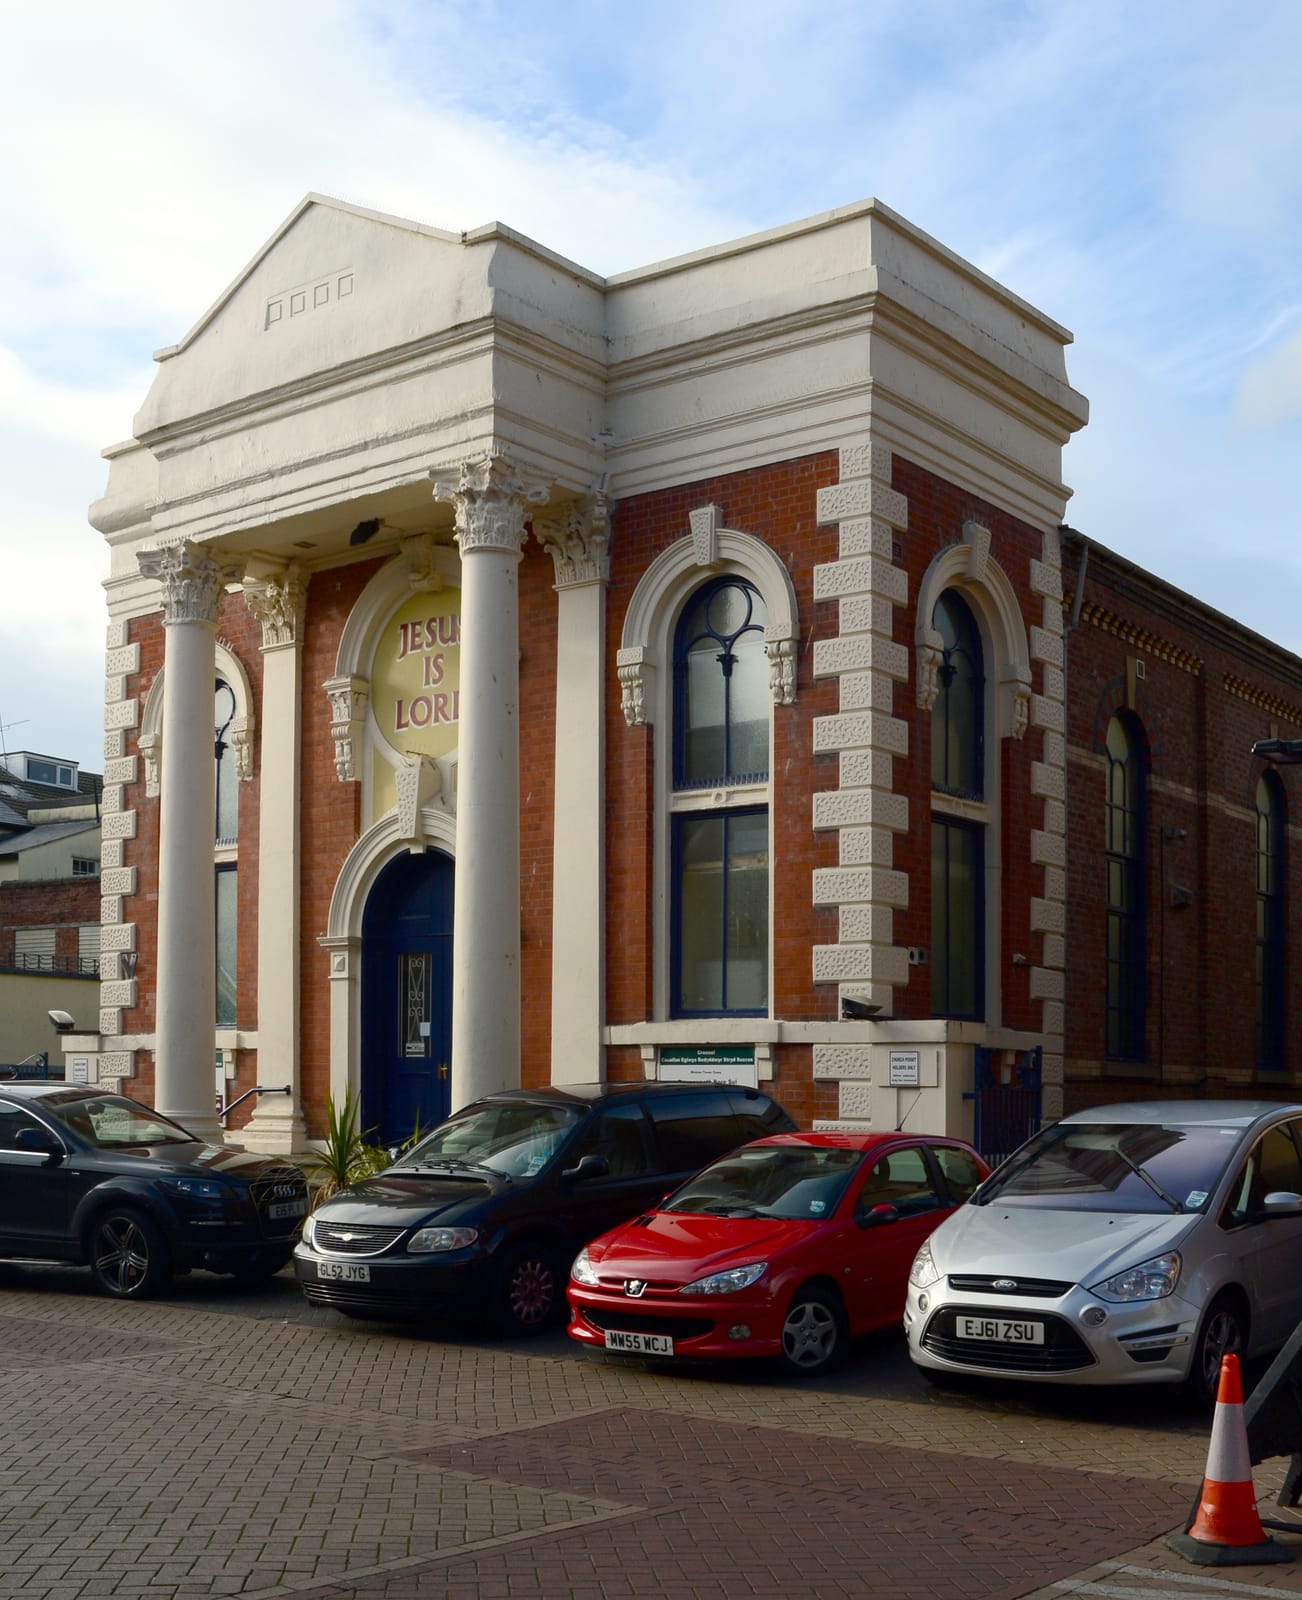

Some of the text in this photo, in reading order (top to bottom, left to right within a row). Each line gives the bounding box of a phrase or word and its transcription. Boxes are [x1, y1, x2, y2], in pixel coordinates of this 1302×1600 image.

[396, 614, 461, 662] JESU
[423, 653, 444, 688] IS
[320, 1263, 366, 1280] GL52 JYG
[965, 1319, 1034, 1340] EJ61 ZSU
[610, 1332, 668, 1352] MW55 WCJ
